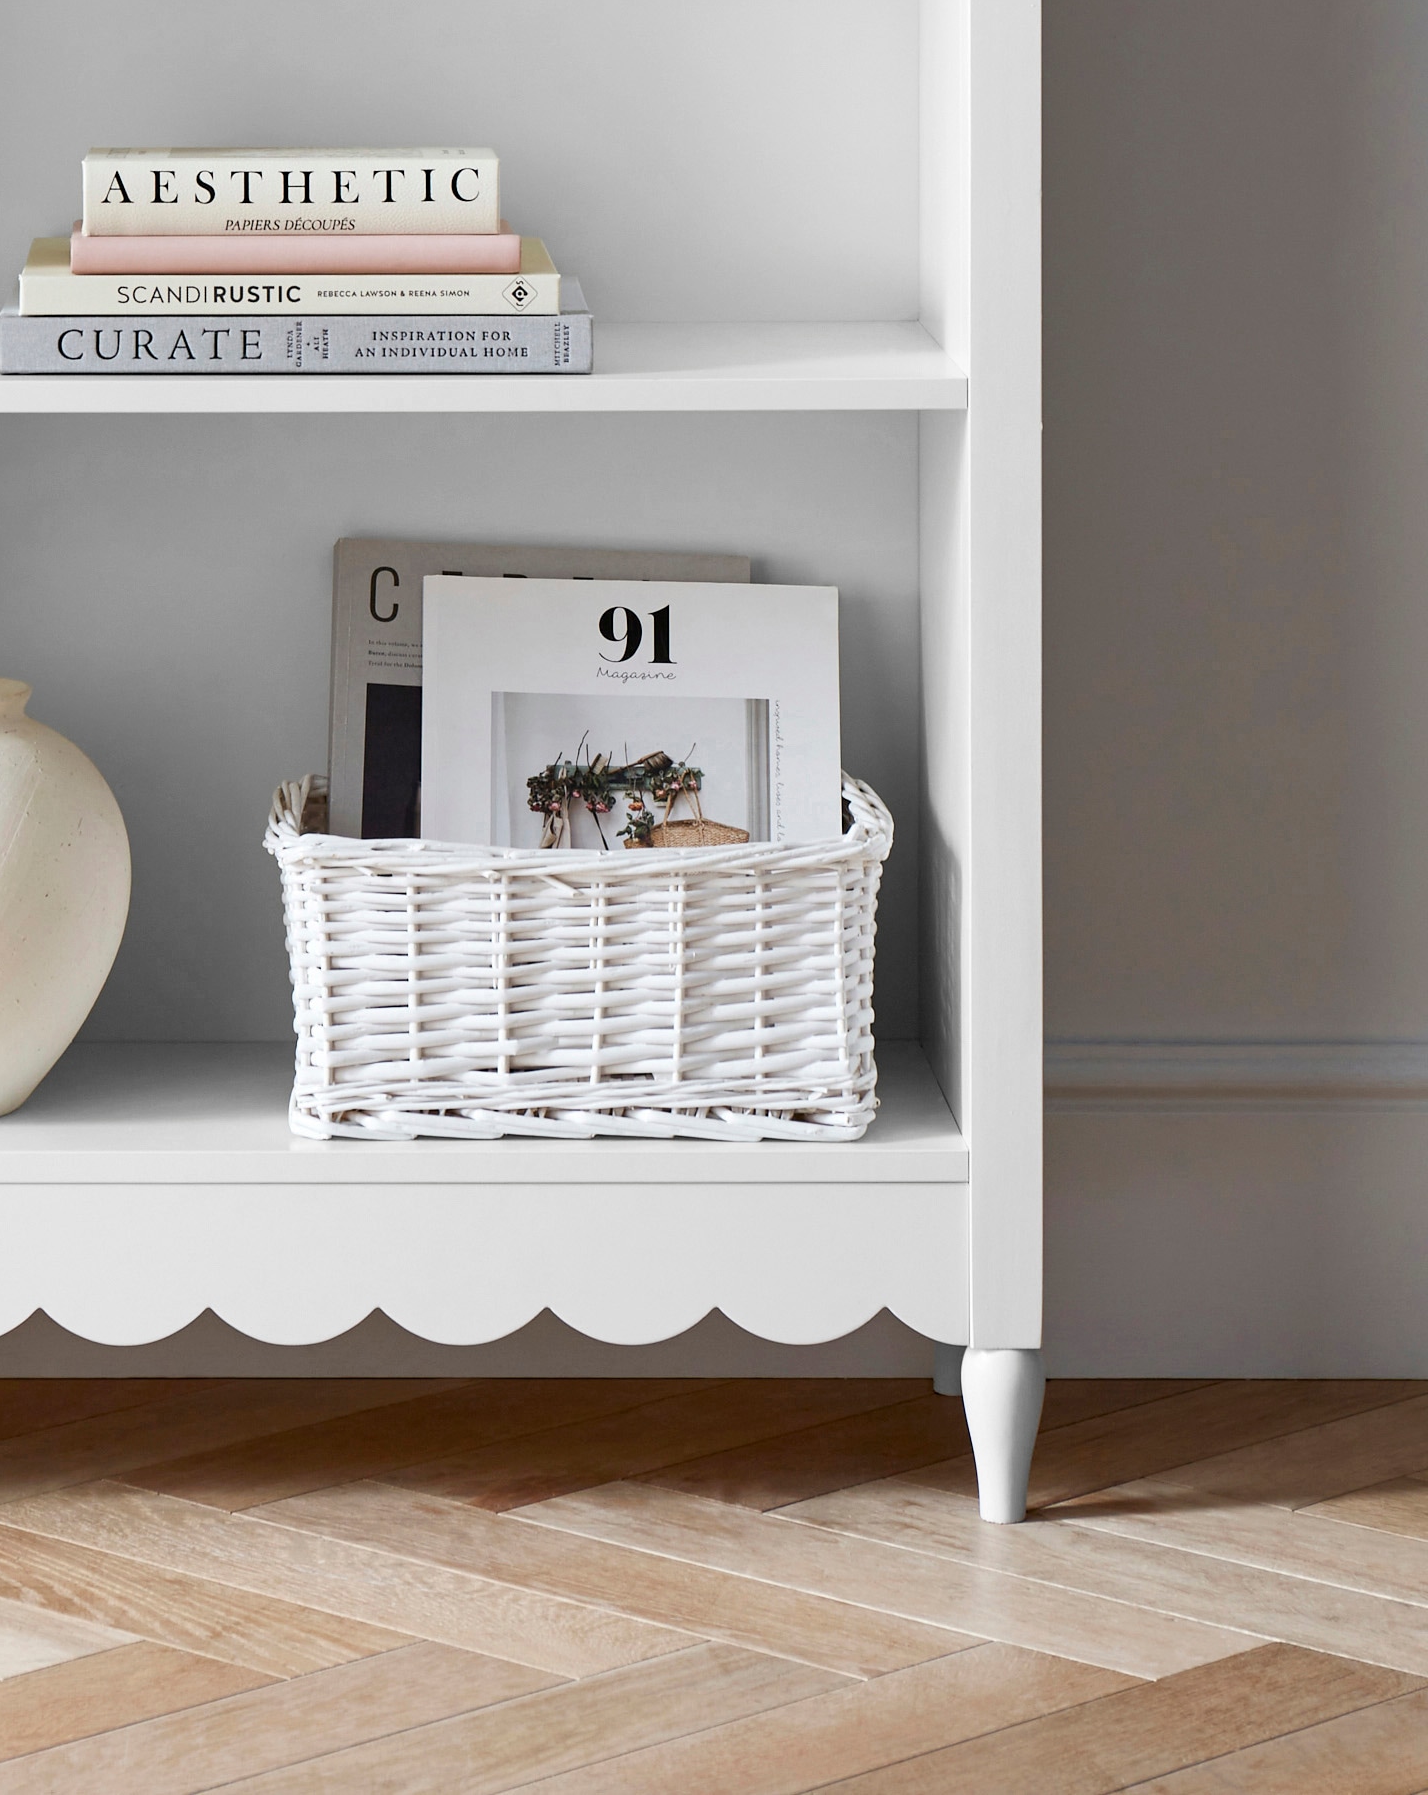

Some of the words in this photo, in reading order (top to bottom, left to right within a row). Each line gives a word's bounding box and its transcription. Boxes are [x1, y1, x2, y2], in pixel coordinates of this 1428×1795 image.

[100, 167, 481, 205] AESTHETIC
[225, 219, 281, 231] PAPIERS
[284, 217, 356, 231] DÉCOUPÉS
[317, 290, 357, 298] REBECCA
[360, 290, 397, 298] LAWSON
[57, 328, 263, 361] CURATE
[372, 331, 476, 341] INSPIRATION
[482, 331, 512, 341] FOR
[354, 347, 376, 357] AN
[381, 347, 478, 357] INDIVIDUAL
[483, 347, 529, 357] HOME
[597, 604, 678, 665] 91
[596, 666, 677, 684] Magazine
[776, 809, 785, 829] and
